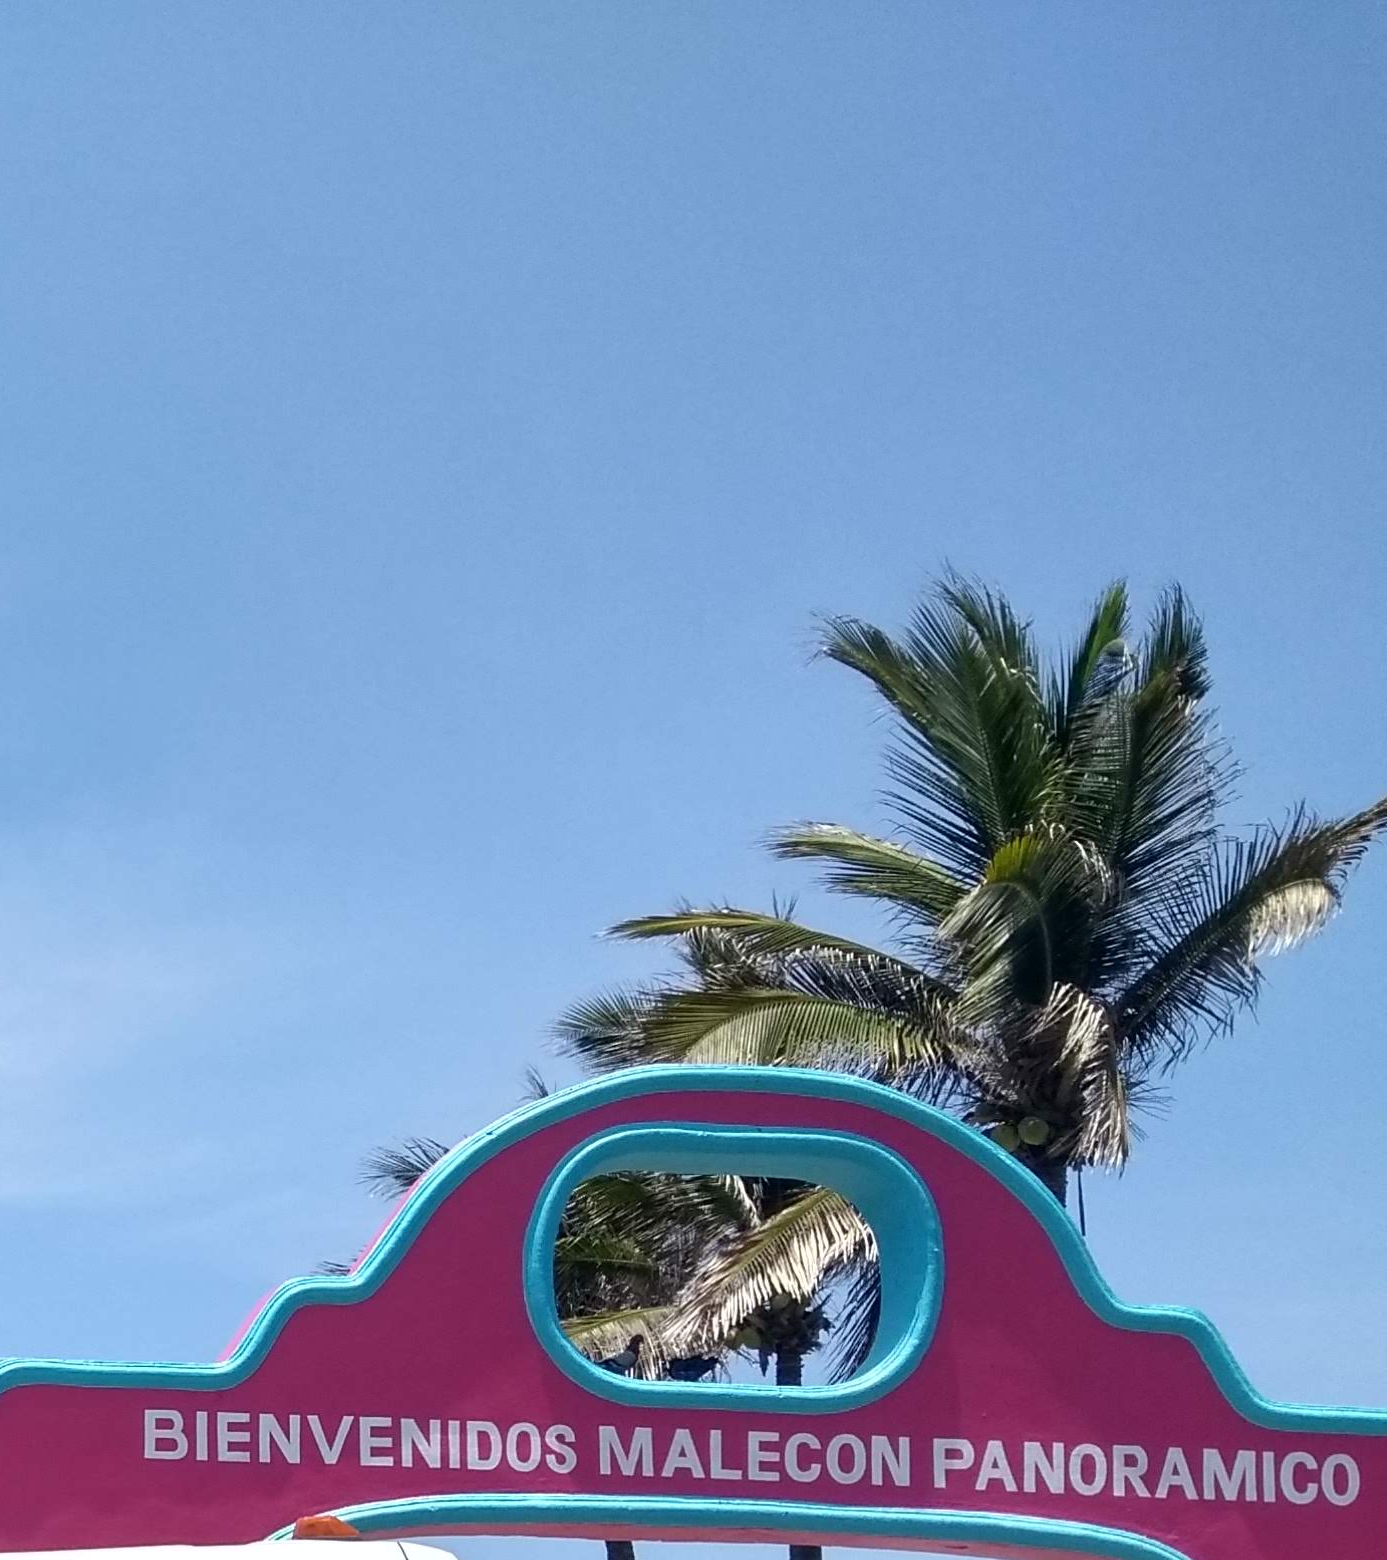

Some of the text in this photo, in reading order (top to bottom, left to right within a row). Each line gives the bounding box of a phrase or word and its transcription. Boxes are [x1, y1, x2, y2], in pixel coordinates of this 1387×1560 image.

[143, 1409, 1360, 1506] BIENVENIDOS MALECON PANORAMICO
